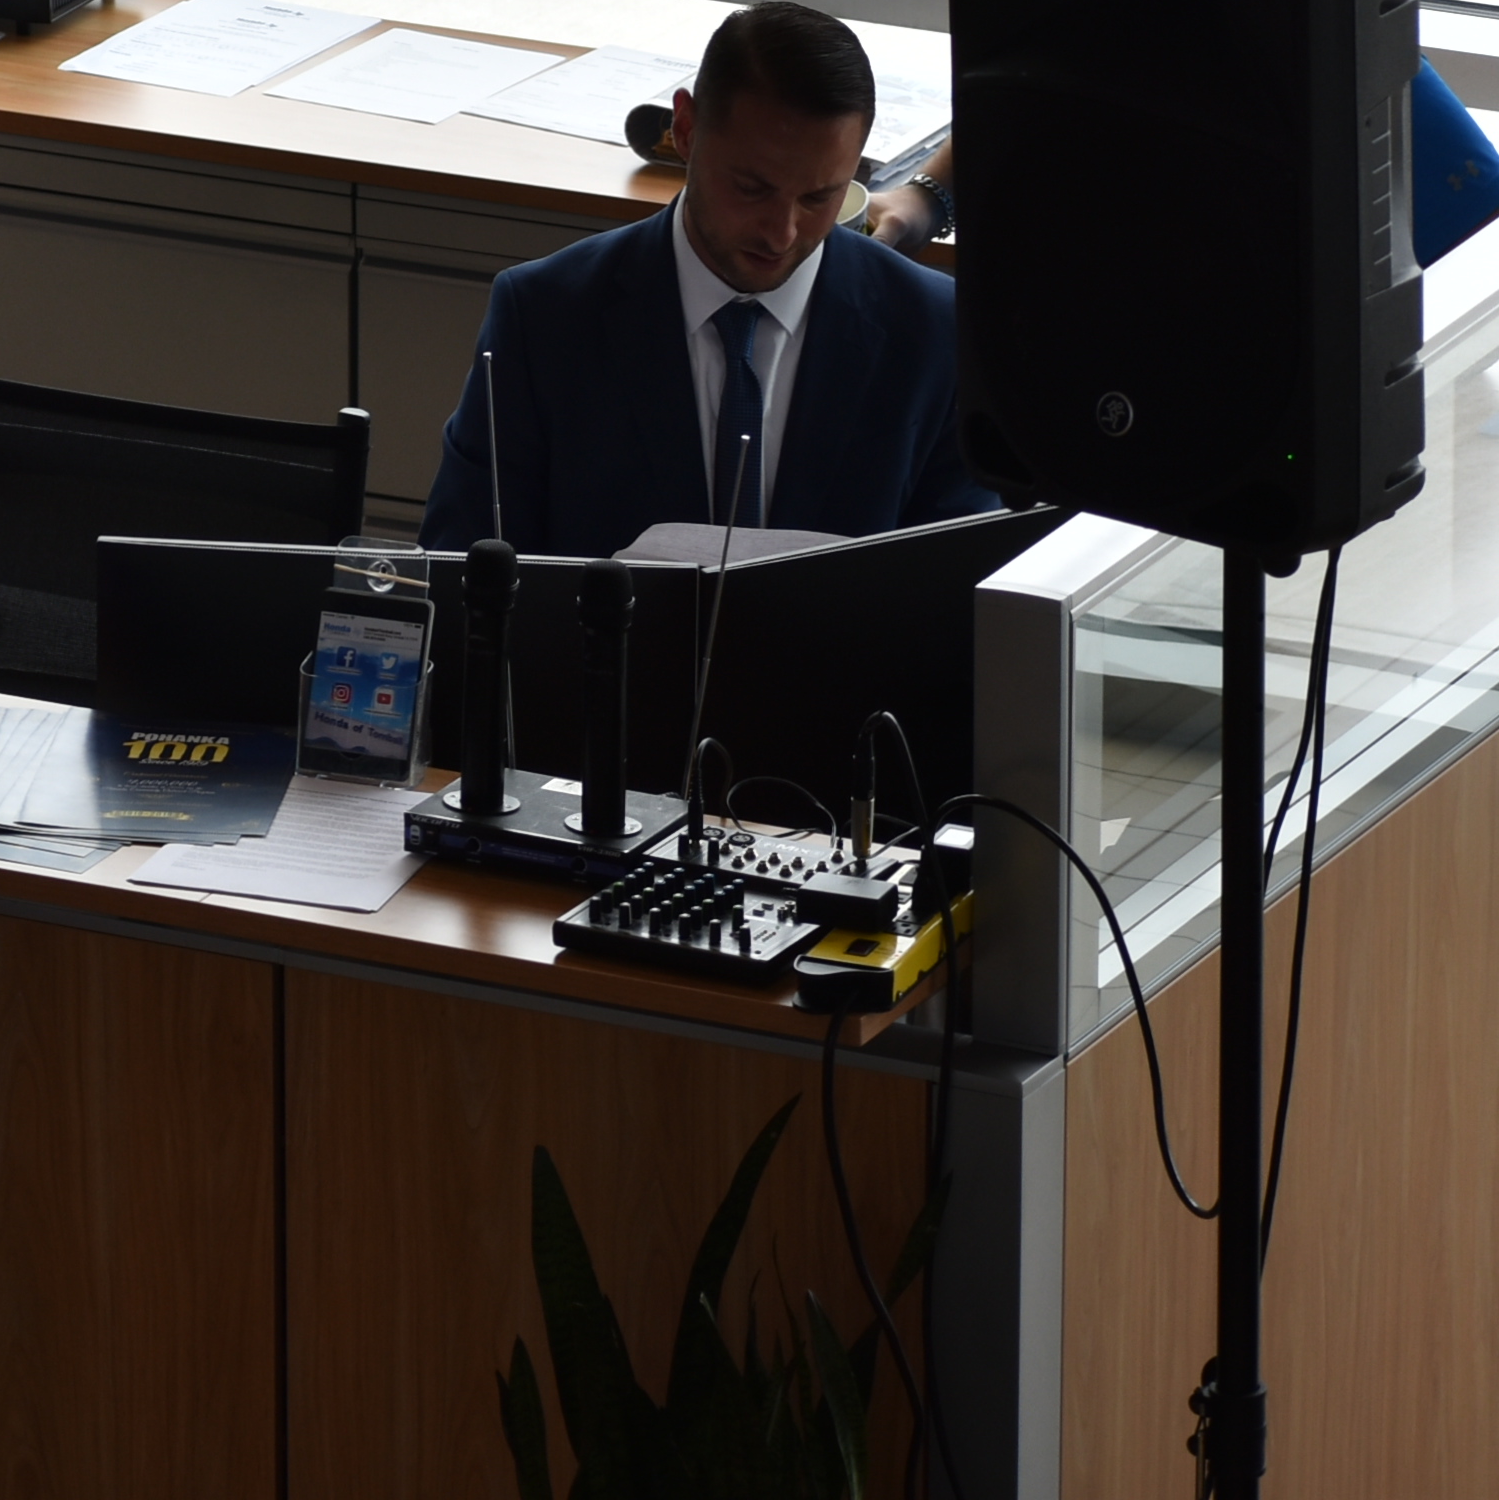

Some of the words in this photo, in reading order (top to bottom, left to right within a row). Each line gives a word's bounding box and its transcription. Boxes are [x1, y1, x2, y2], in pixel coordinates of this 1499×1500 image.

[314, 711, 349, 729] Honda
[131, 731, 230, 745] POHANKA
[123, 740, 230, 763] 100
